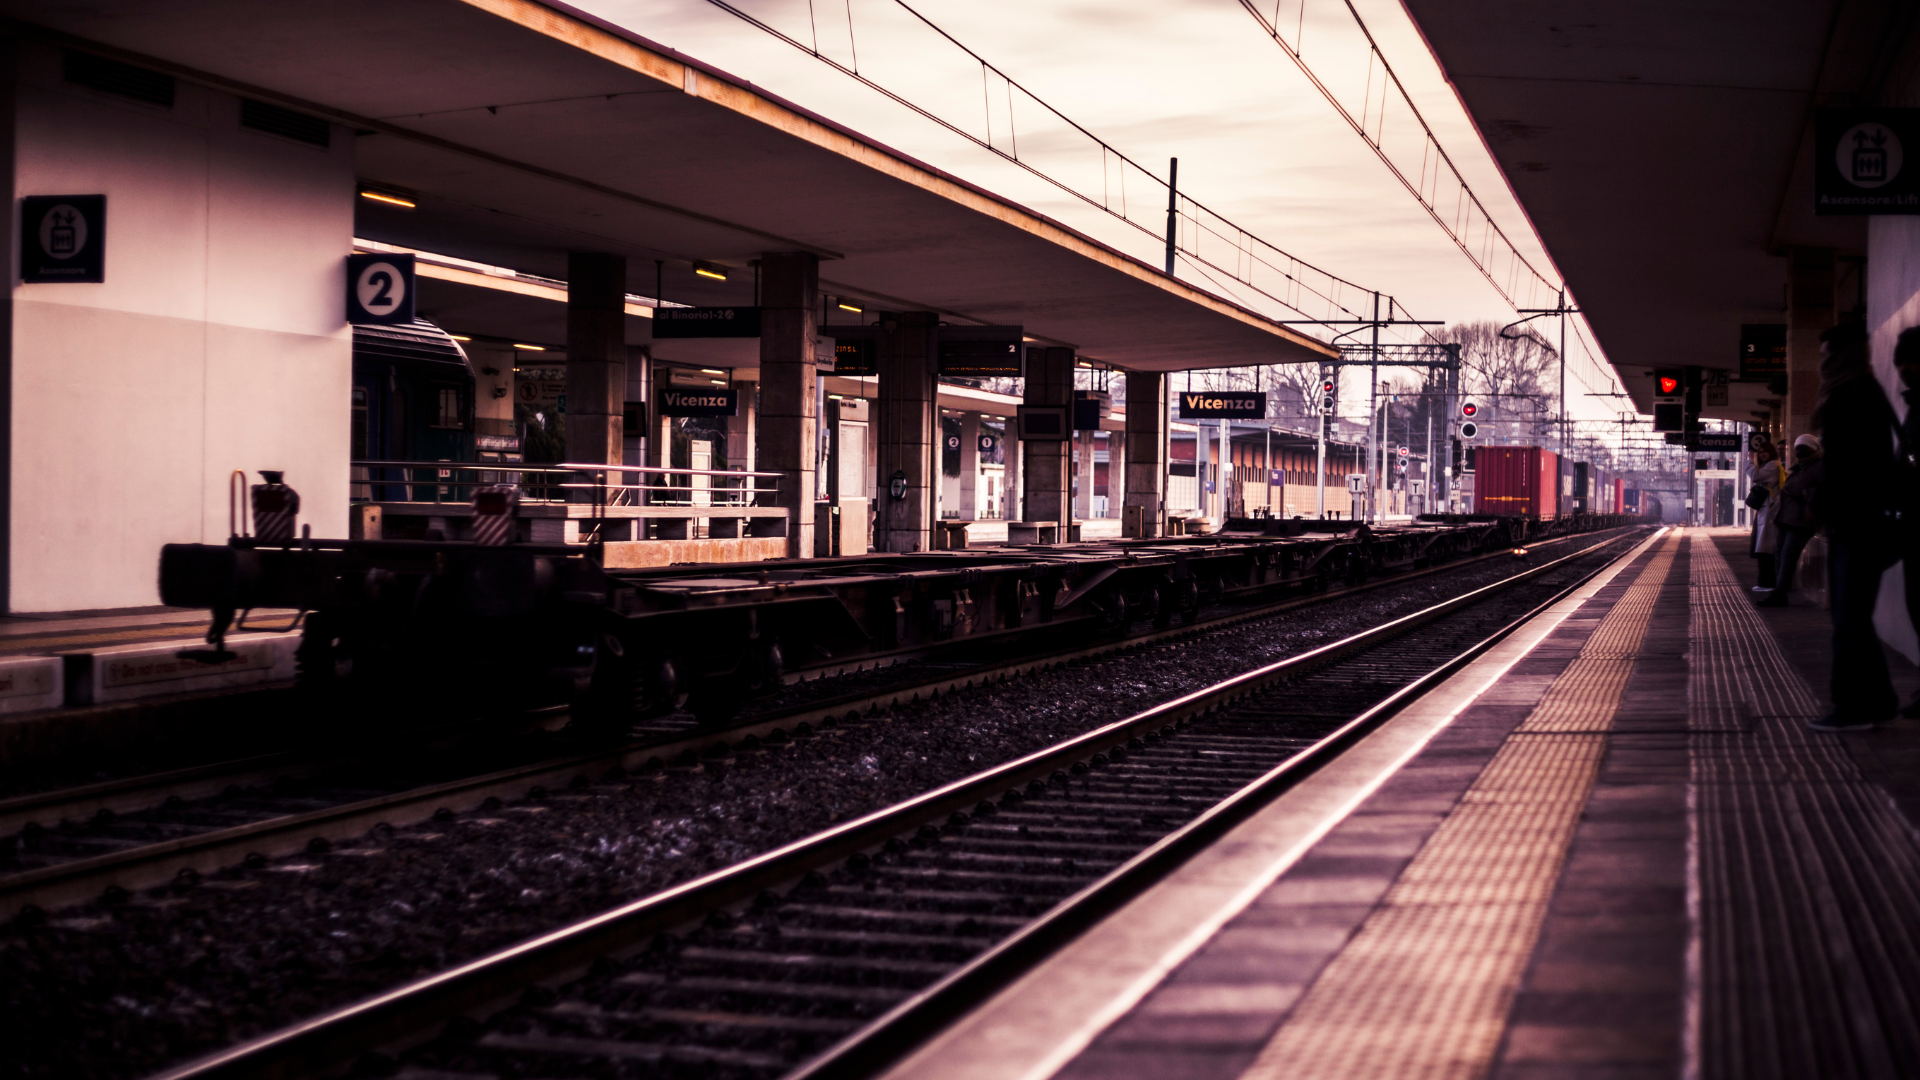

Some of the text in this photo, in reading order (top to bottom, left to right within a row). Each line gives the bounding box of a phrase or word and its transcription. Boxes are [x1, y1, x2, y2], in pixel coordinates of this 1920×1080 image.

[368, 271, 392, 306] 2
[659, 310, 670, 320] al
[1008, 344, 1016, 353] 2
[1746, 343, 1756, 353] 3
[664, 392, 728, 407] Vicenza
[1186, 395, 1256, 410] Vicenza
[1698, 436, 1736, 447] icenza
[1353, 478, 1360, 491] T
[1412, 483, 1419, 494] T
